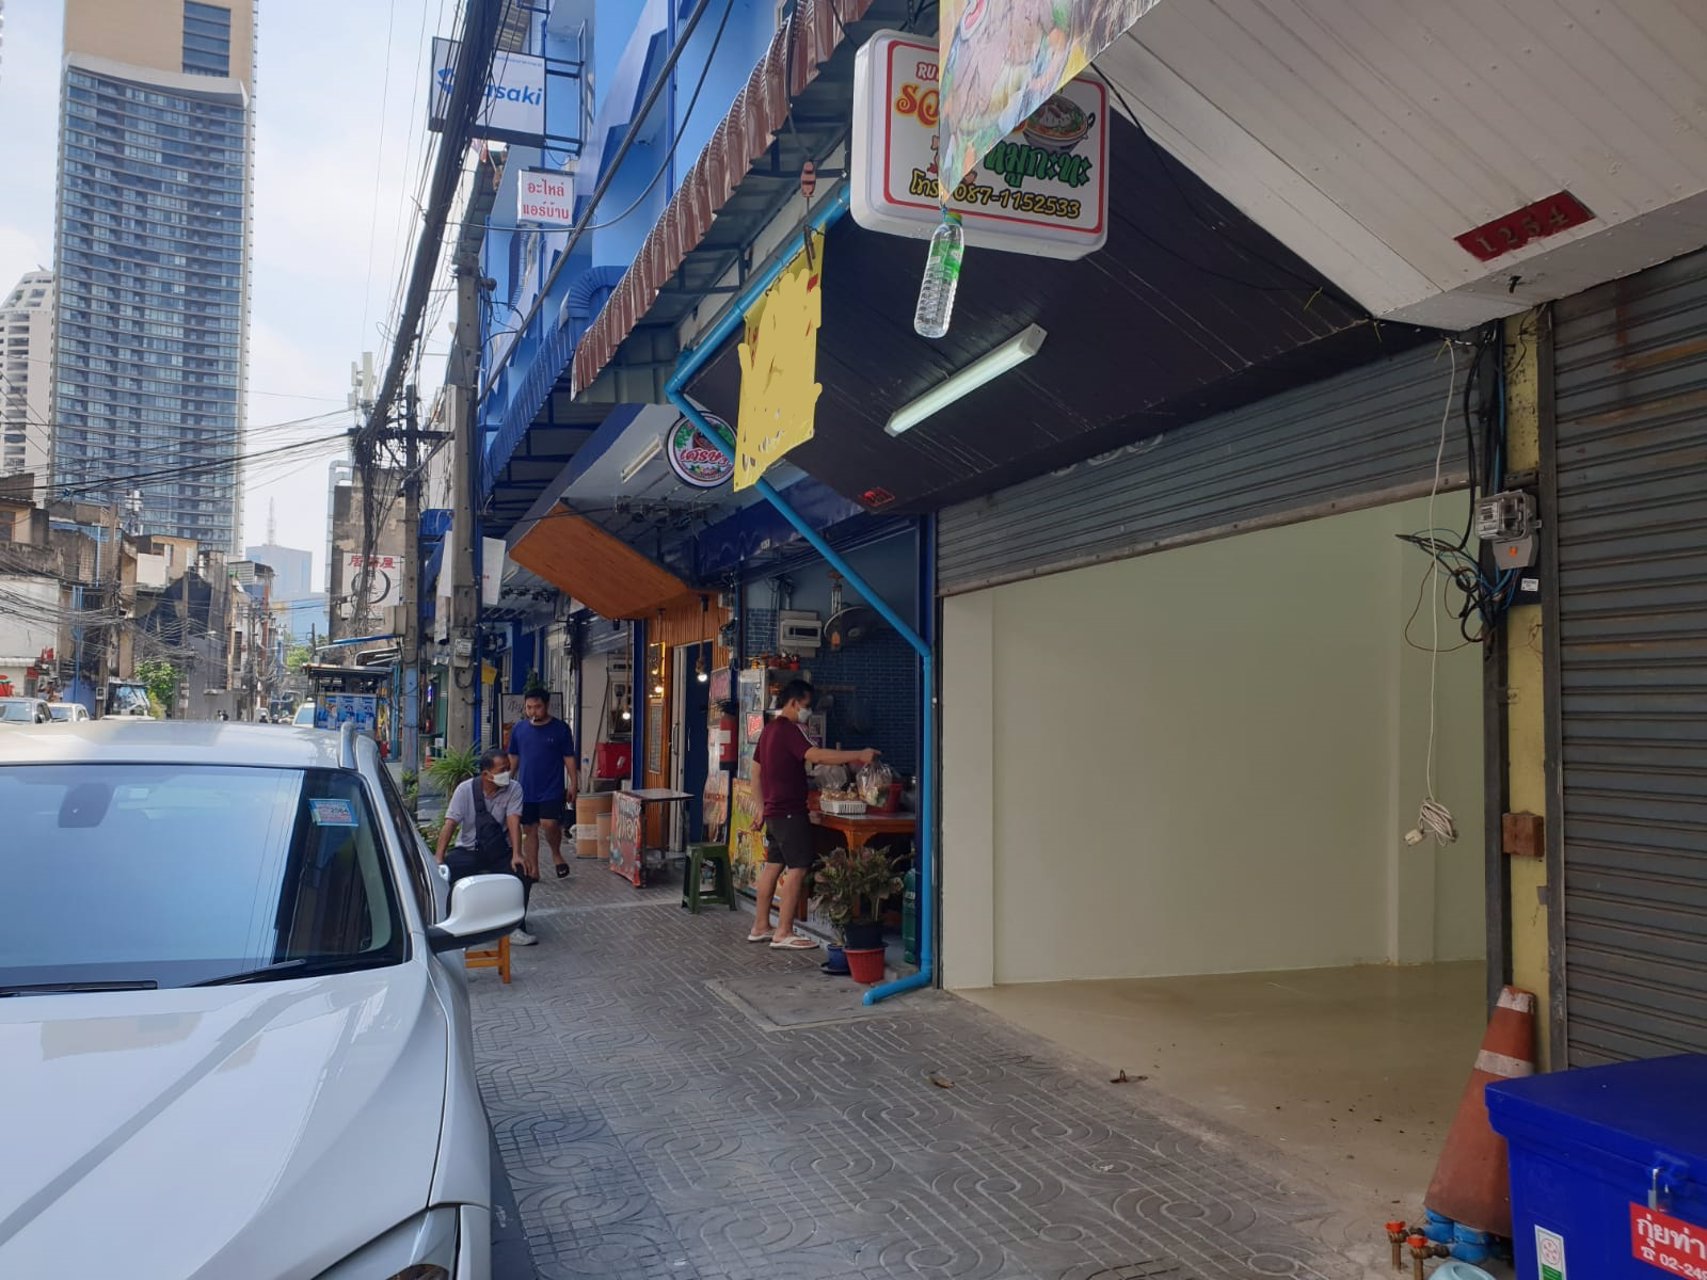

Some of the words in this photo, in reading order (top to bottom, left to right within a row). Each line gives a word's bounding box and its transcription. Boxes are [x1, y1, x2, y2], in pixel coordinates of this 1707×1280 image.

[916, 62, 939, 81] RU
[527, 178, 565, 197] อะไหล่
[522, 200, 570, 220] แอร์บ้าน
[952, 183, 1082, 219] 087-1152533
